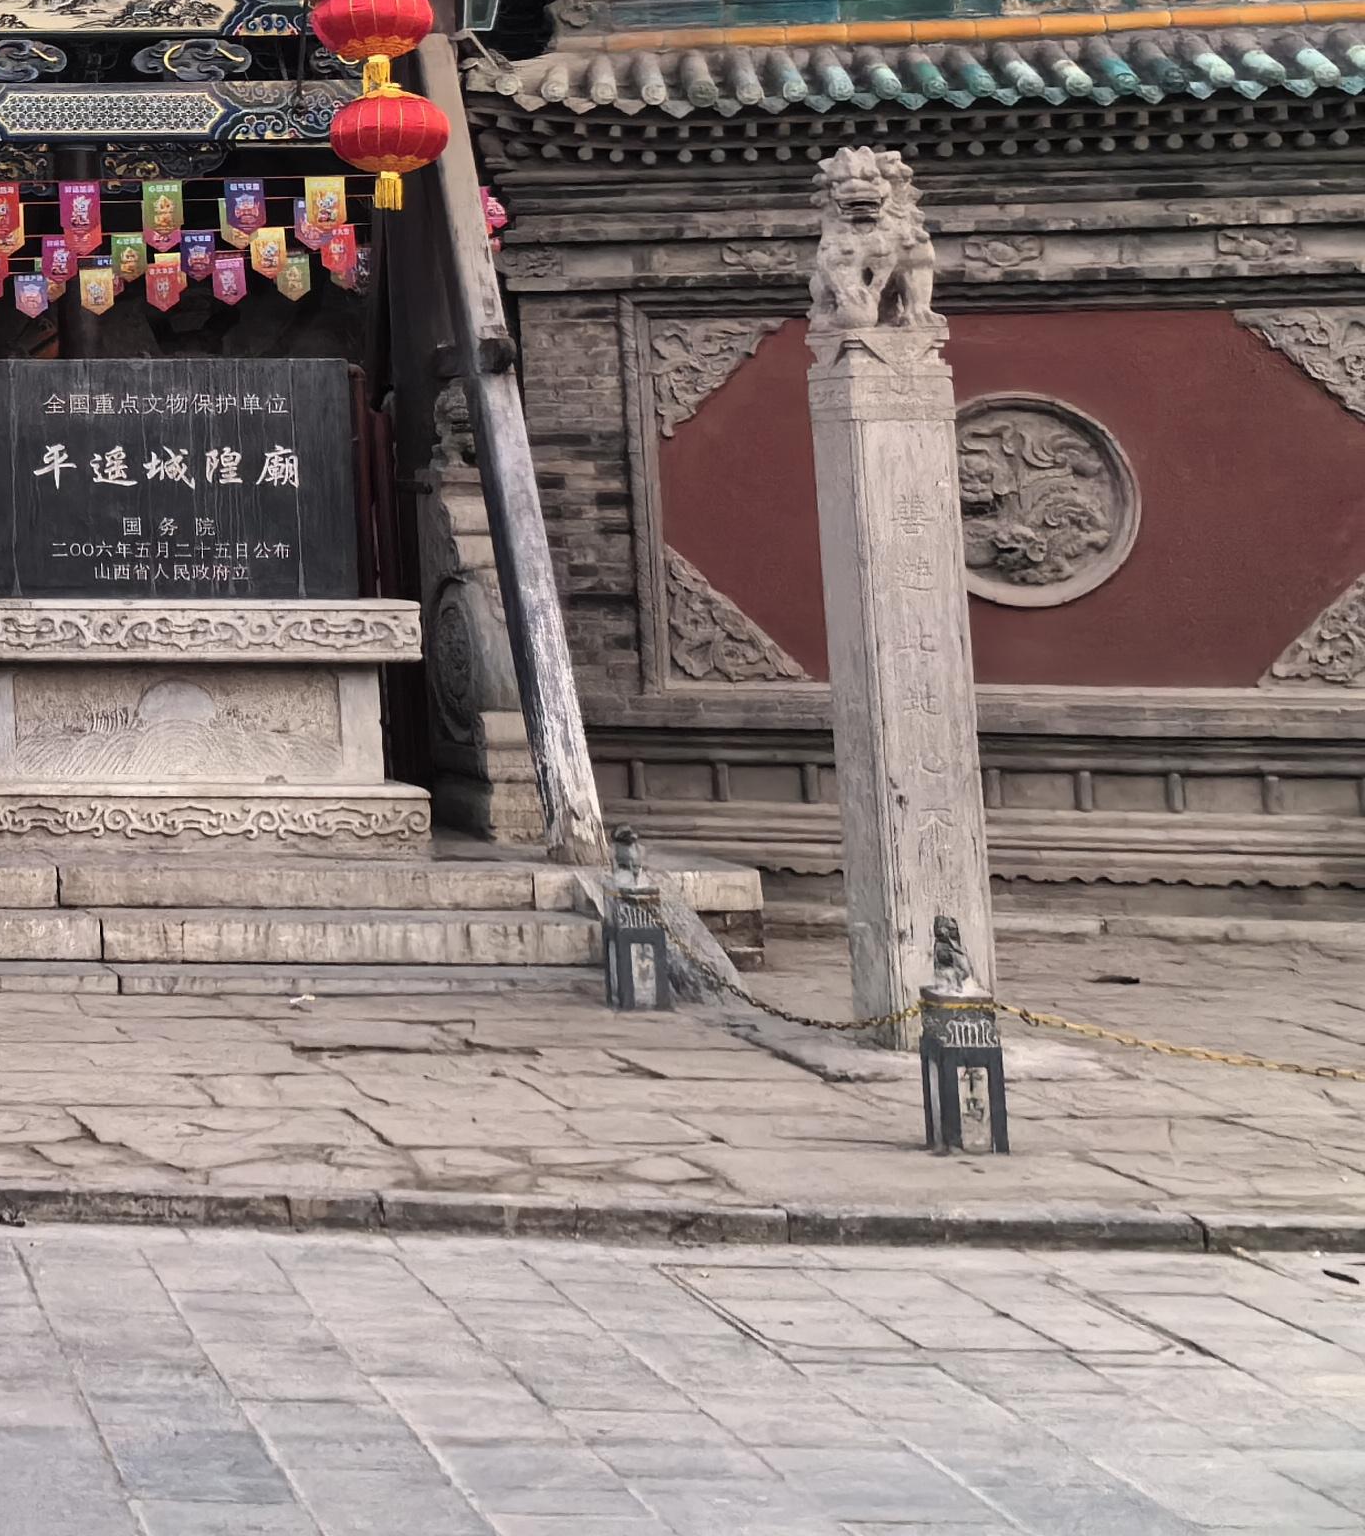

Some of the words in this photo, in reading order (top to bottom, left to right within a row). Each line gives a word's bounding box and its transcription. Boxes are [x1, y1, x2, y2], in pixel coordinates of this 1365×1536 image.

[43, 392, 289, 416] 全国重点文物保护单位
[122, 516, 217, 537] 国务院
[94, 563, 251, 581] 山西省人民政府立
